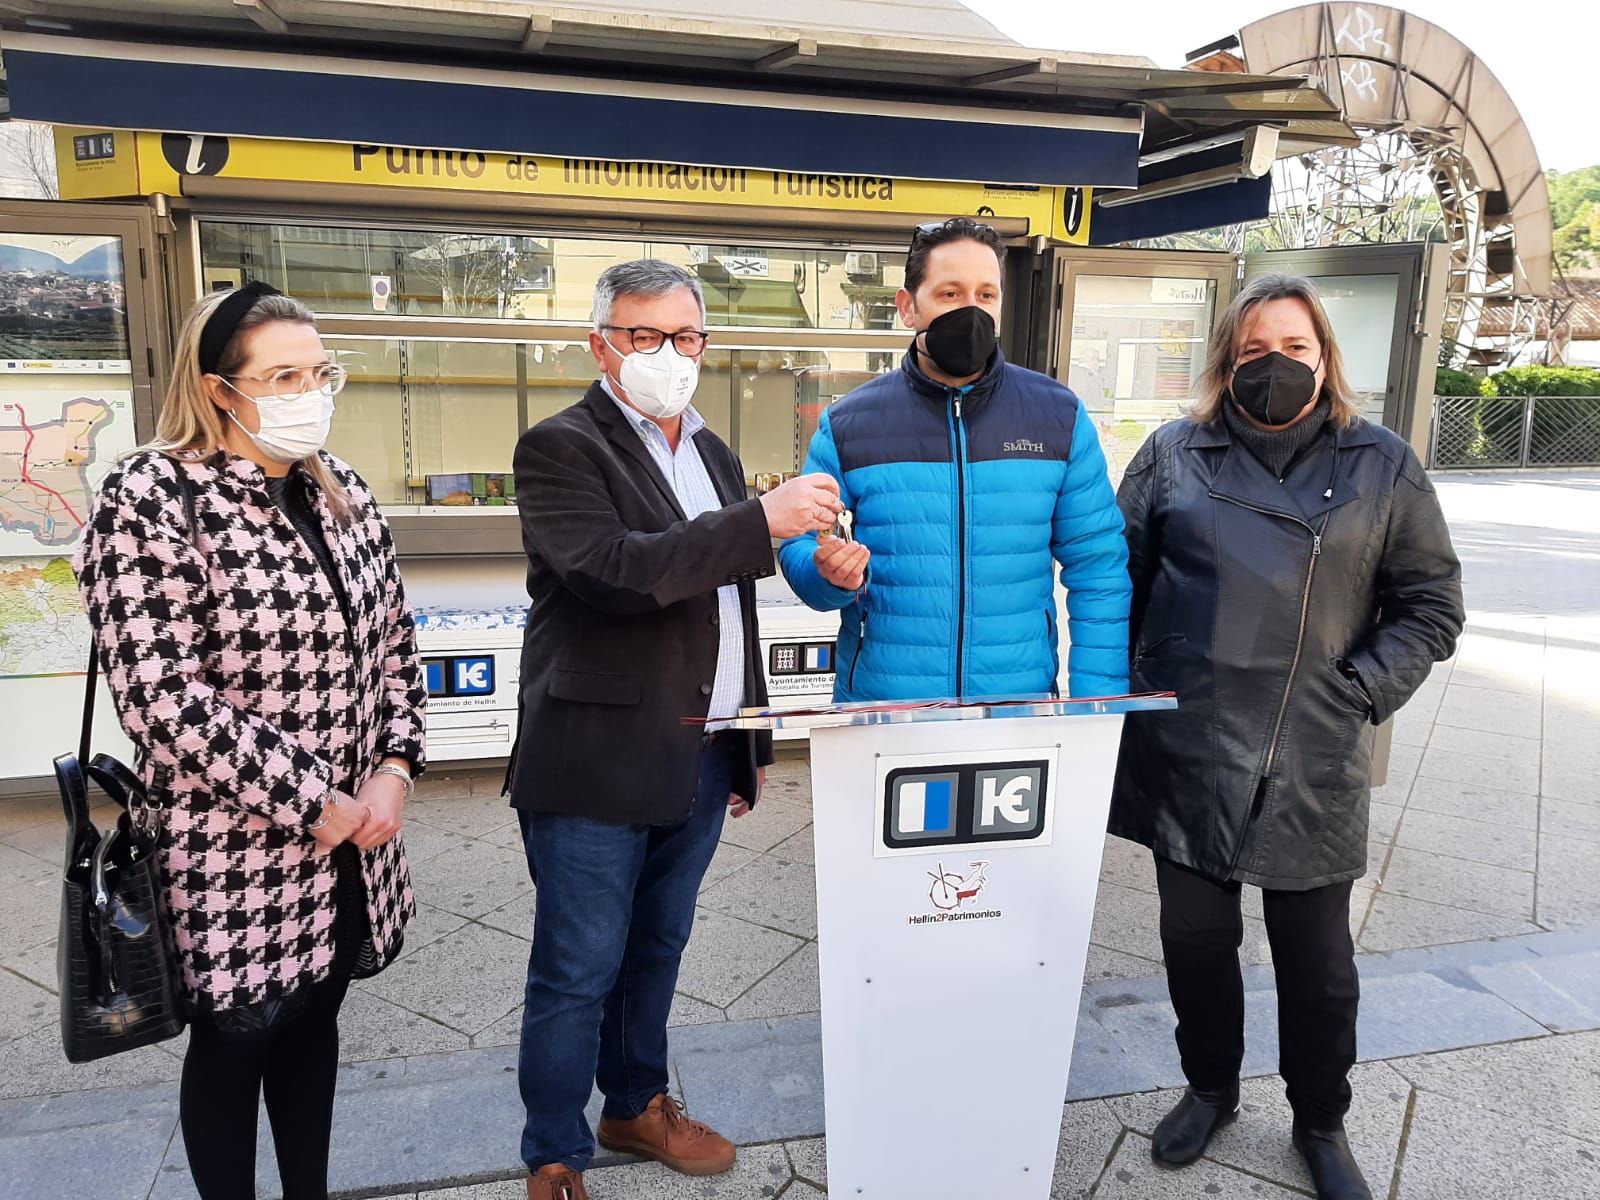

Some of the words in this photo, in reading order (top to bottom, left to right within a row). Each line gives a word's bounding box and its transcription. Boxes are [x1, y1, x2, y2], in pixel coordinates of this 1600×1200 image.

[353, 144, 486, 178] Punto
[506, 154, 539, 181] de
[1003, 442, 1044, 453] SMITH
[769, 676, 827, 686] Ayuntamiento
